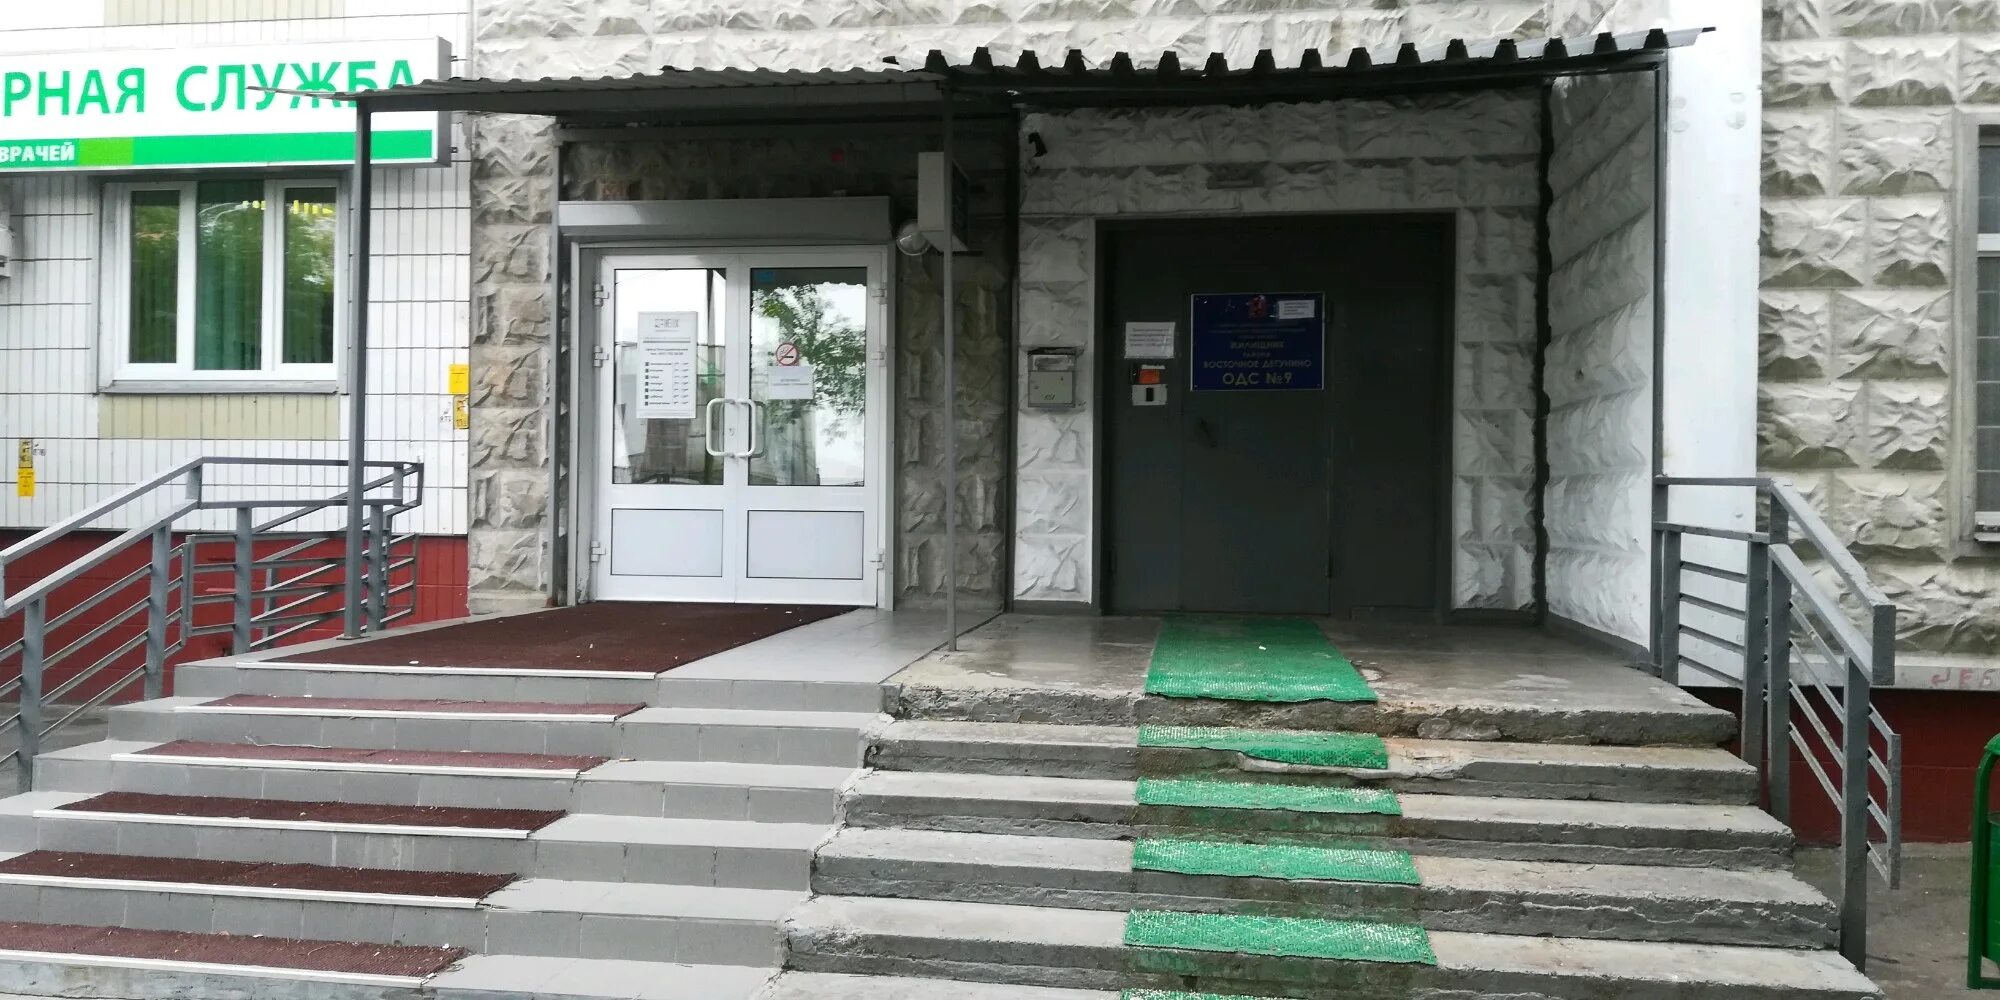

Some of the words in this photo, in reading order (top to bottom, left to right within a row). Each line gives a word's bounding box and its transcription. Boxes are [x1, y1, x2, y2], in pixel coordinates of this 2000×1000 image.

[4, 67, 146, 116] РНАЯ
[0, 141, 75, 163] ВРАЧЕЙ
[1203, 359, 1260, 369] ВОСТОЧНОЕ
[1222, 372, 1260, 386] ОДС
